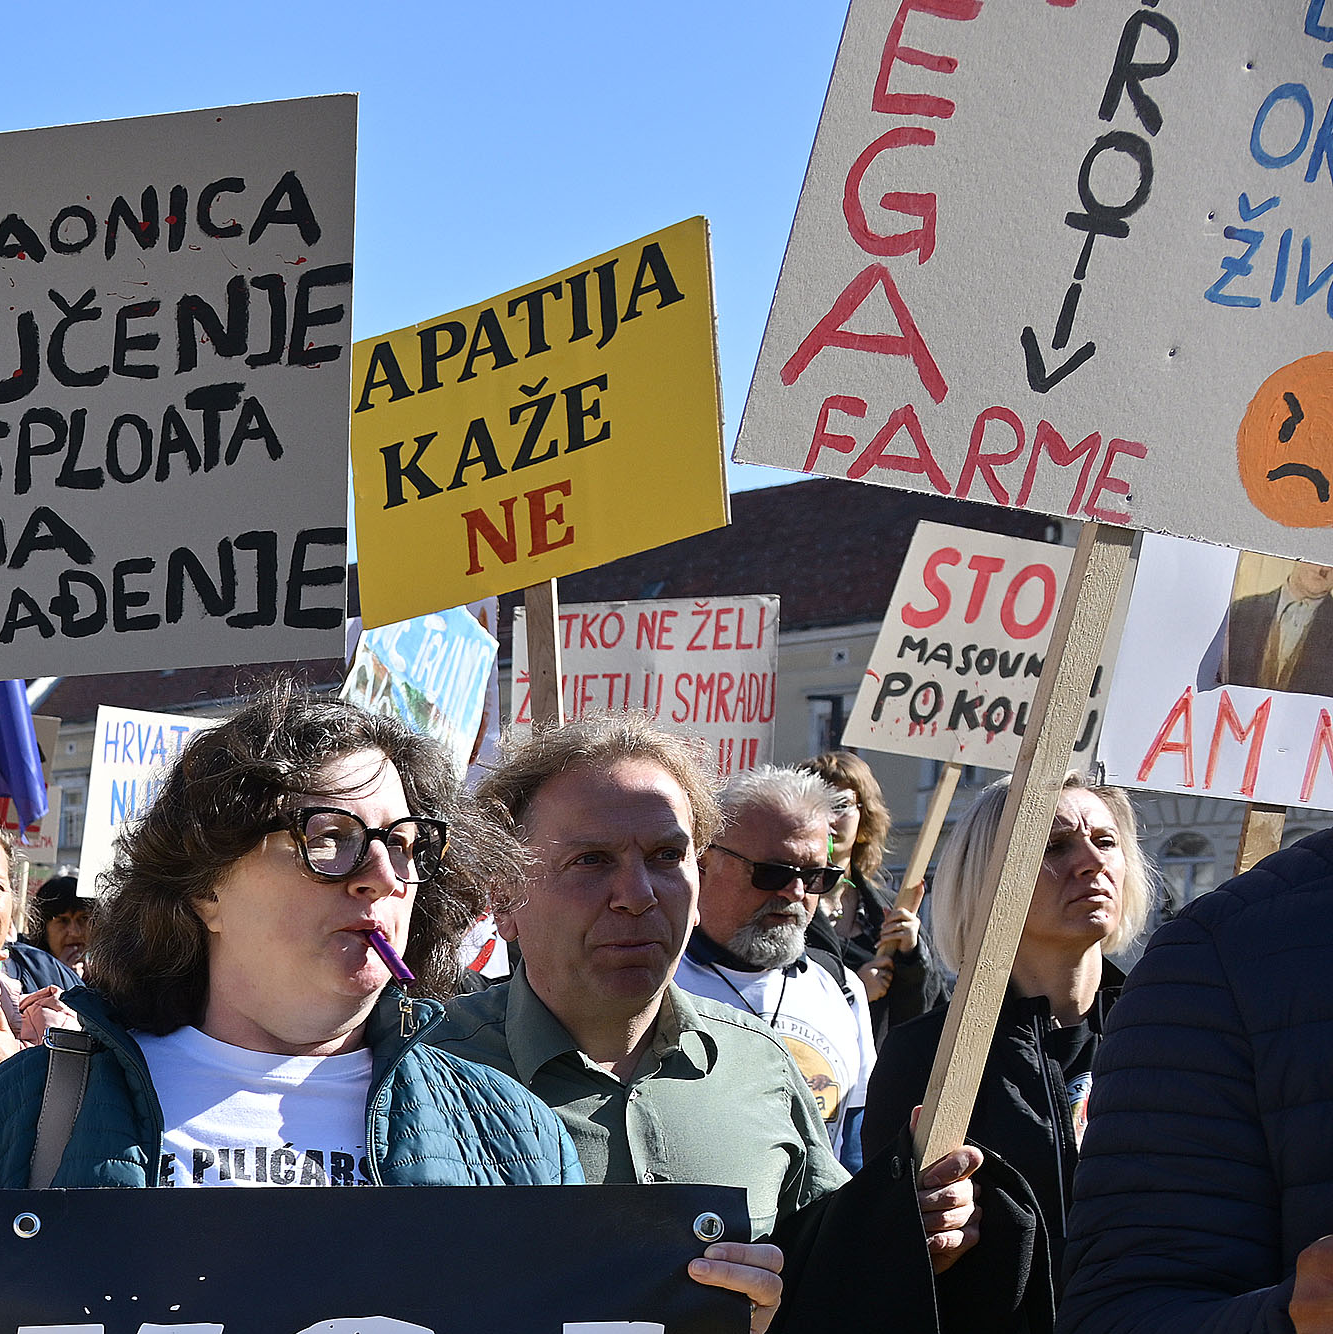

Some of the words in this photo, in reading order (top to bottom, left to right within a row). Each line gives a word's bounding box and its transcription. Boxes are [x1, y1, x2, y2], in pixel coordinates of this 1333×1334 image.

[780, 0, 983, 404] EGA
[1204, 192, 1333, 320] ŽIV
[354, 241, 686, 415] APATIJA
[379, 372, 612, 510] KAŽE
[805, 394, 1148, 524] FARME
[460, 478, 575, 577] NE
[636, 610, 679, 651] NE
[687, 601, 766, 651] ŽELI
[901, 547, 1057, 640] STO
[671, 672, 777, 724] SMRADU
[1136, 685, 1273, 799] AM
